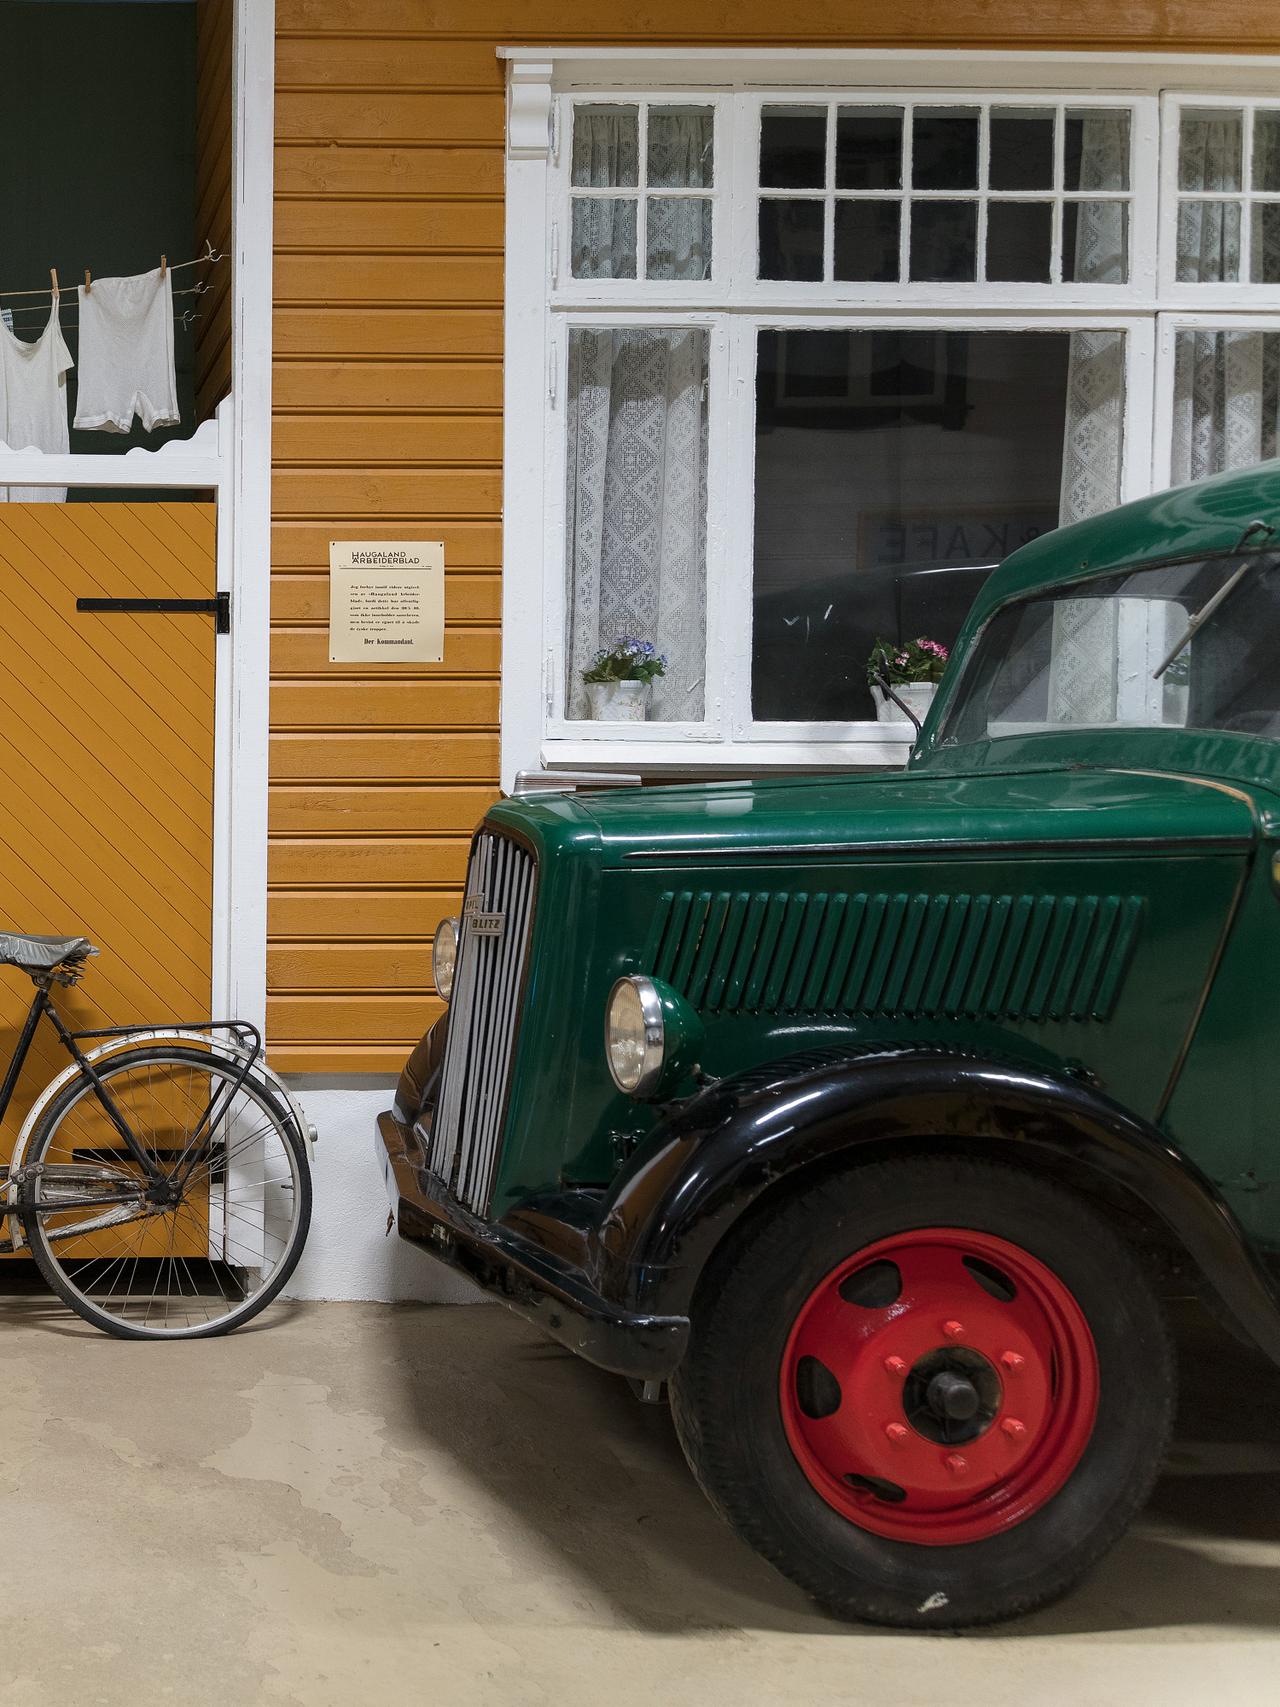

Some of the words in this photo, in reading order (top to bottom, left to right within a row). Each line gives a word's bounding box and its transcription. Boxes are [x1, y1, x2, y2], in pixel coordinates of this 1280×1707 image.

[351, 551, 407, 560] HAUGALAND
[351, 557, 420, 565] ARBEIDERBLAD
[472, 918, 500, 929] BLITZ
